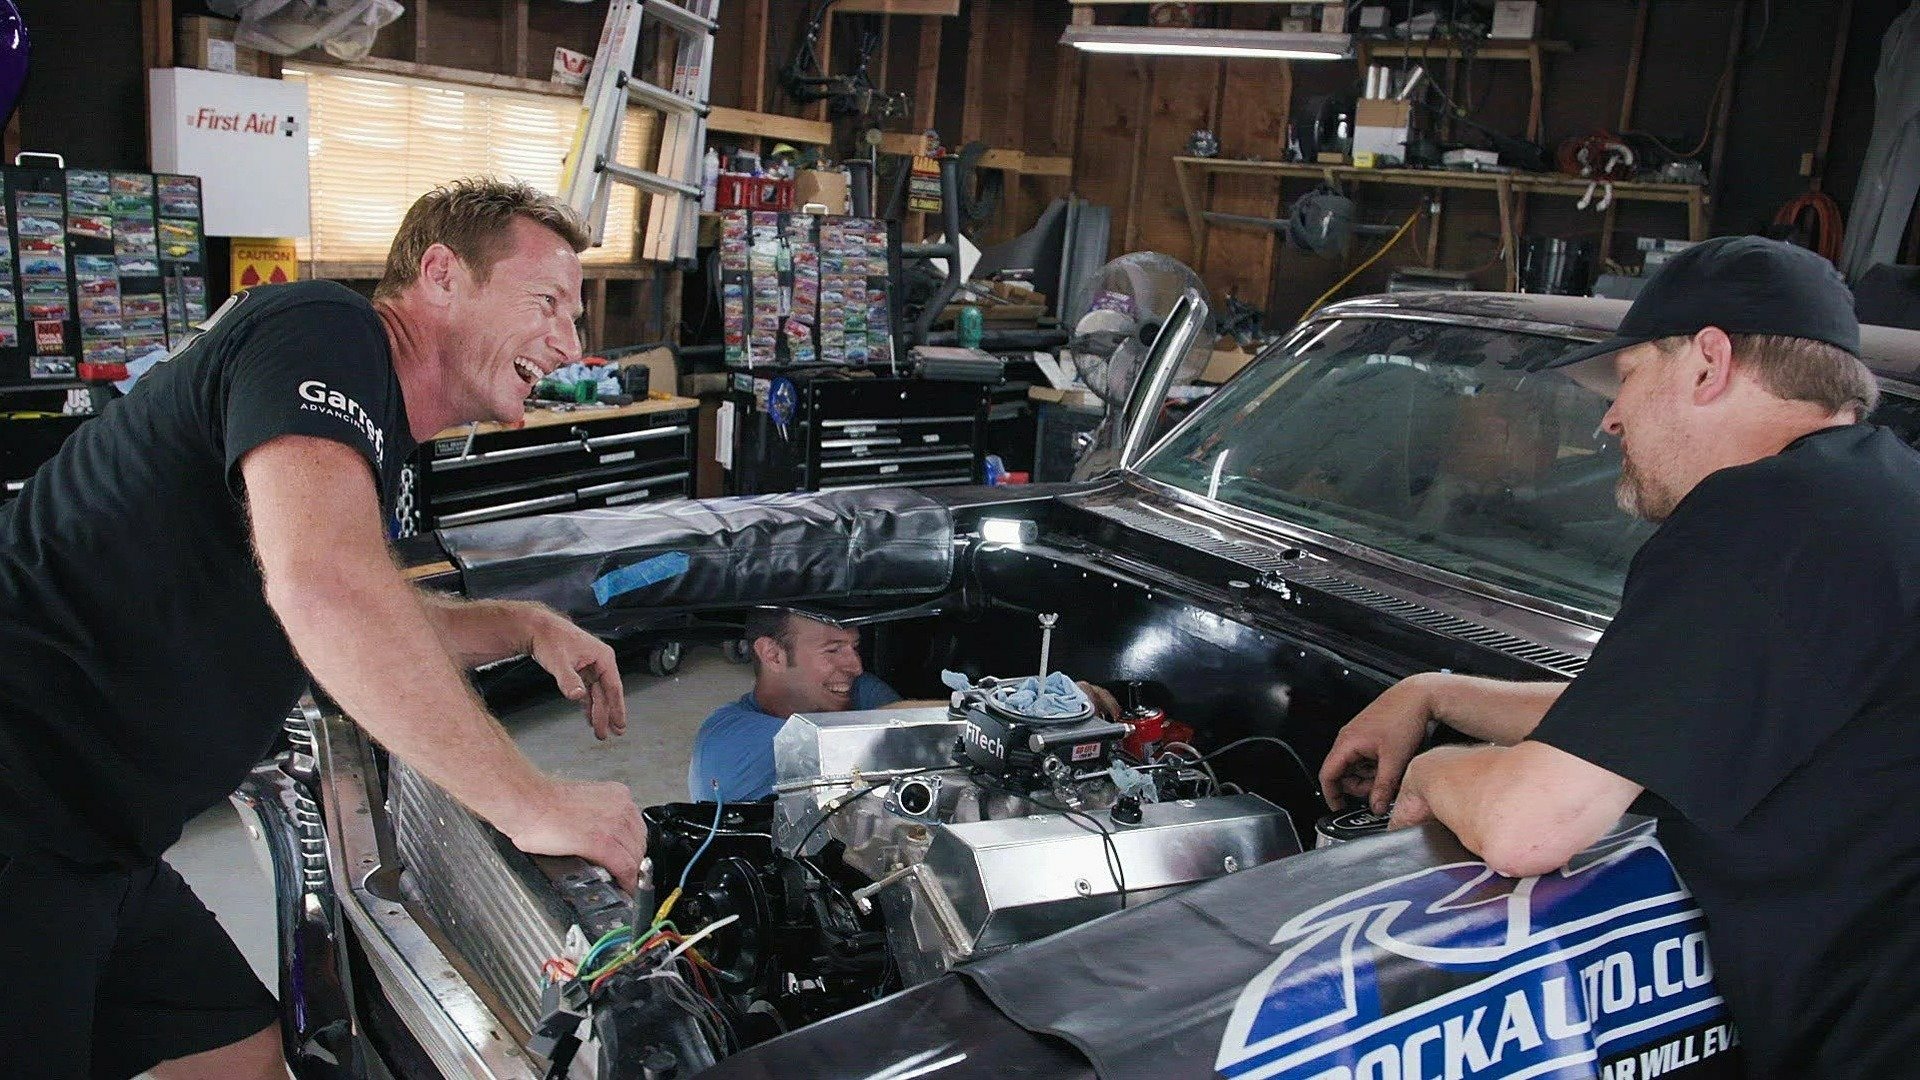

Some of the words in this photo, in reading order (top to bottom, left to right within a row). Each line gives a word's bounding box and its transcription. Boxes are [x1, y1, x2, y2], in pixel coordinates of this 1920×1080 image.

[196, 107, 240, 132] First
[243, 112, 278, 135] Aid
[237, 249, 290, 260] CAUTION
[965, 720, 1005, 760] FiTech
[1639, 1034, 1700, 1080] WILL
